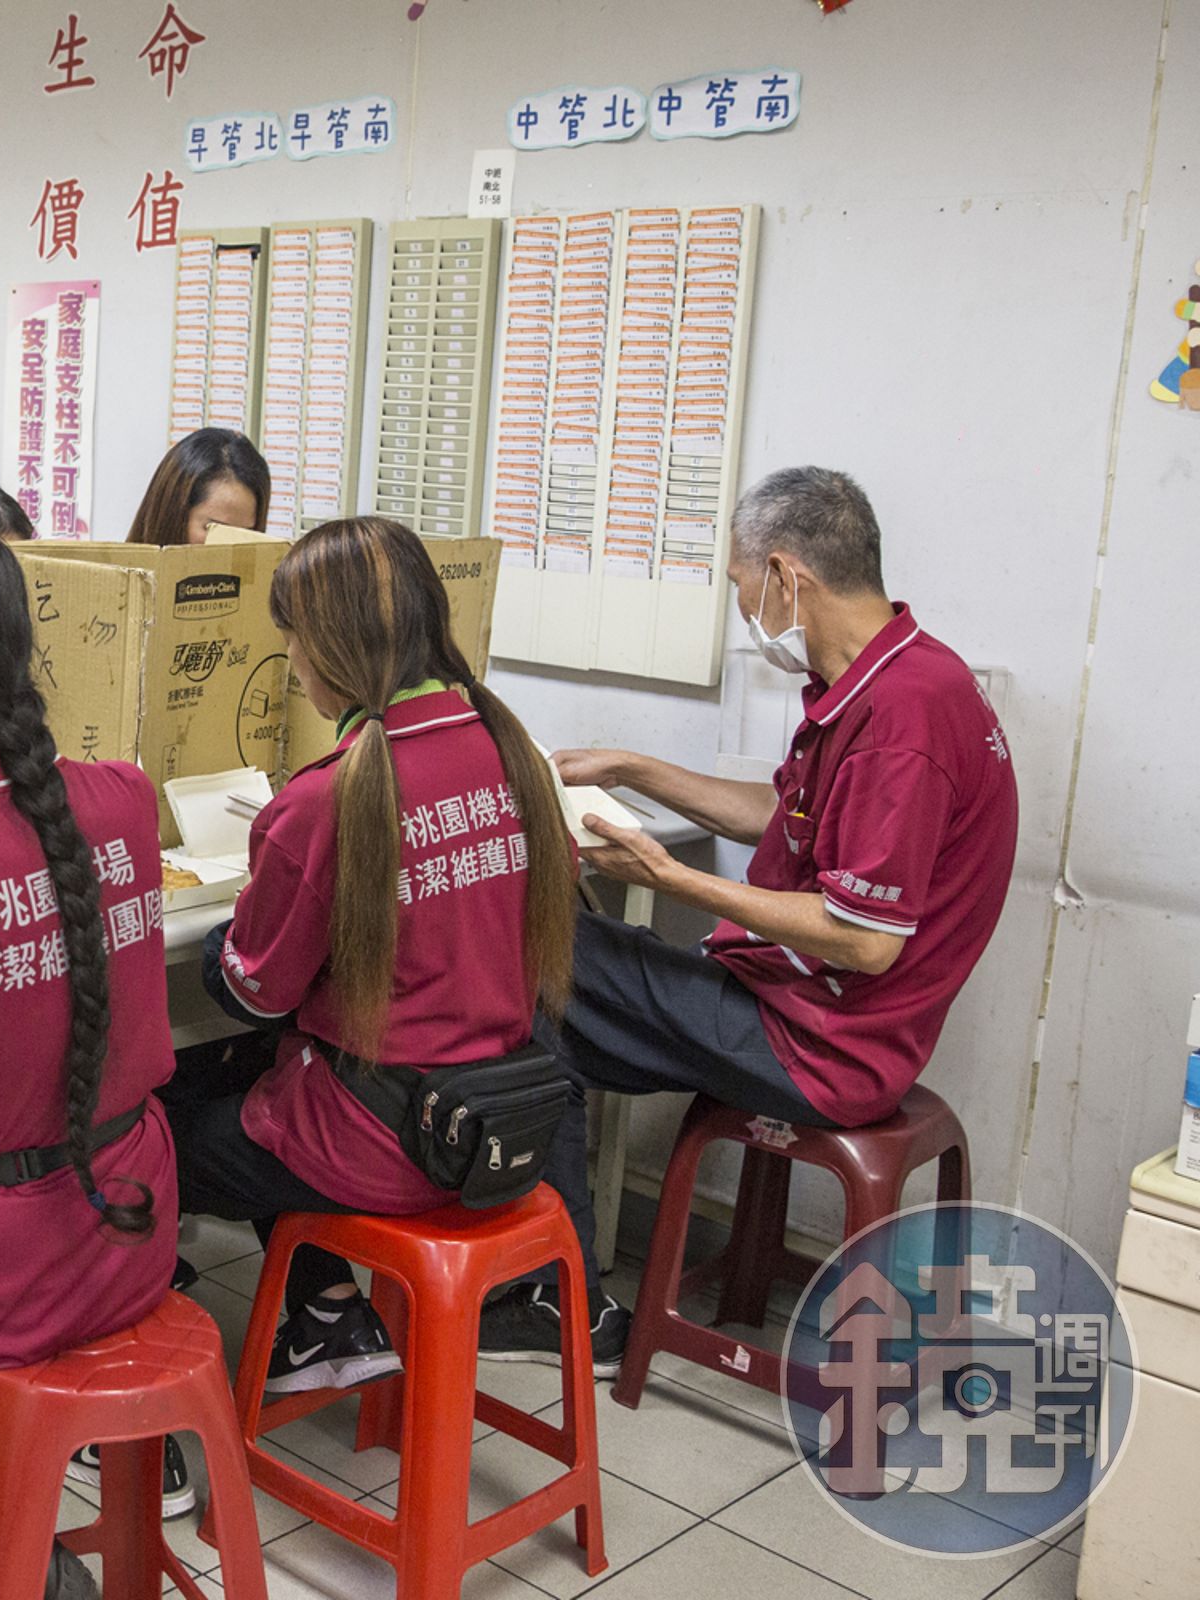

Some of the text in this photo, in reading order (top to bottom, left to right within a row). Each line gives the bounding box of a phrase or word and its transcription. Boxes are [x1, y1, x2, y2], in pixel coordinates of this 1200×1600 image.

[515, 93, 636, 141] 中管北
[656, 74, 789, 127] 中管南
[188, 121, 279, 163] 早管北
[290, 103, 390, 150] 早管南
[16, 317, 47, 539] 安全防護不能
[50, 292, 84, 535] 家庭支柱不可倒
